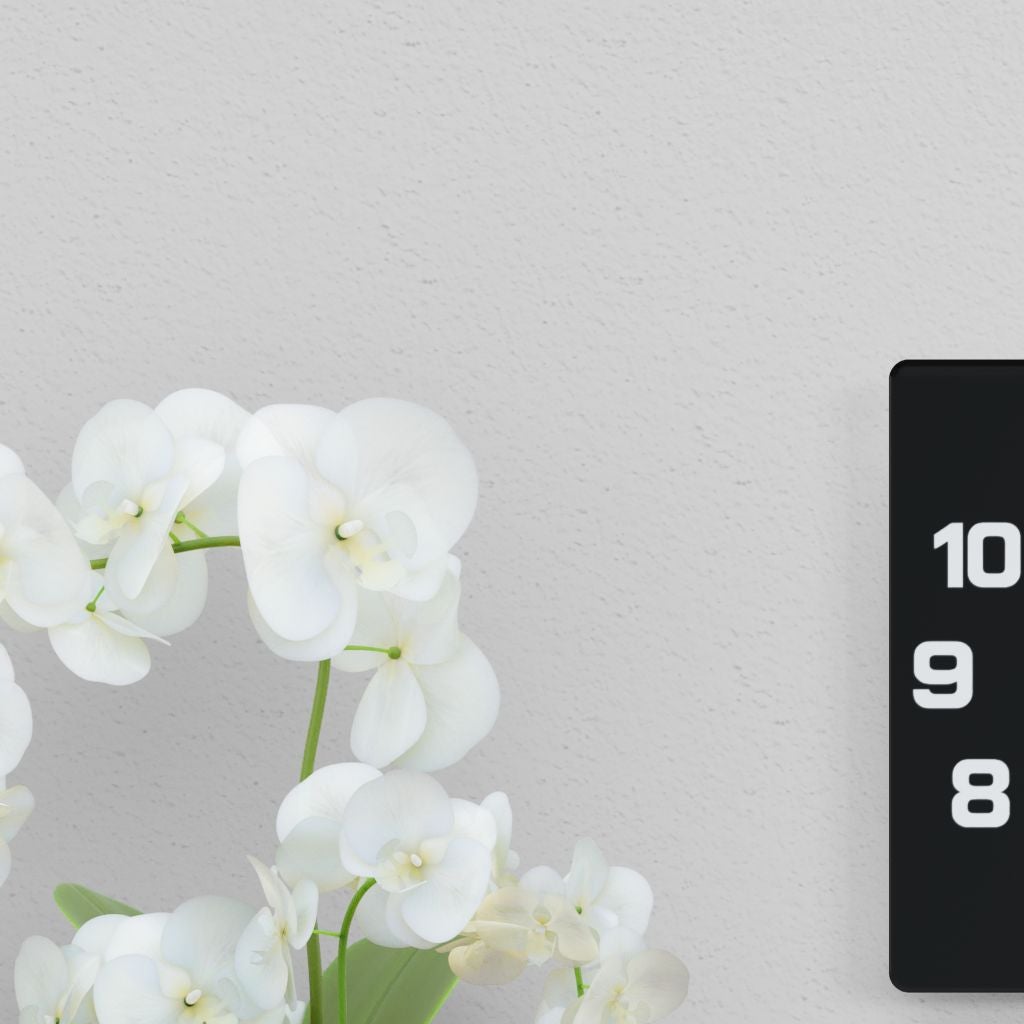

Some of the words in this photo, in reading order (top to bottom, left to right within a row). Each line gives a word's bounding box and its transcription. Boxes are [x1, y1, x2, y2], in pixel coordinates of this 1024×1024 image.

[933, 521, 1022, 589] 10
[912, 640, 974, 710] 9
[951, 758, 1011, 828] 8
